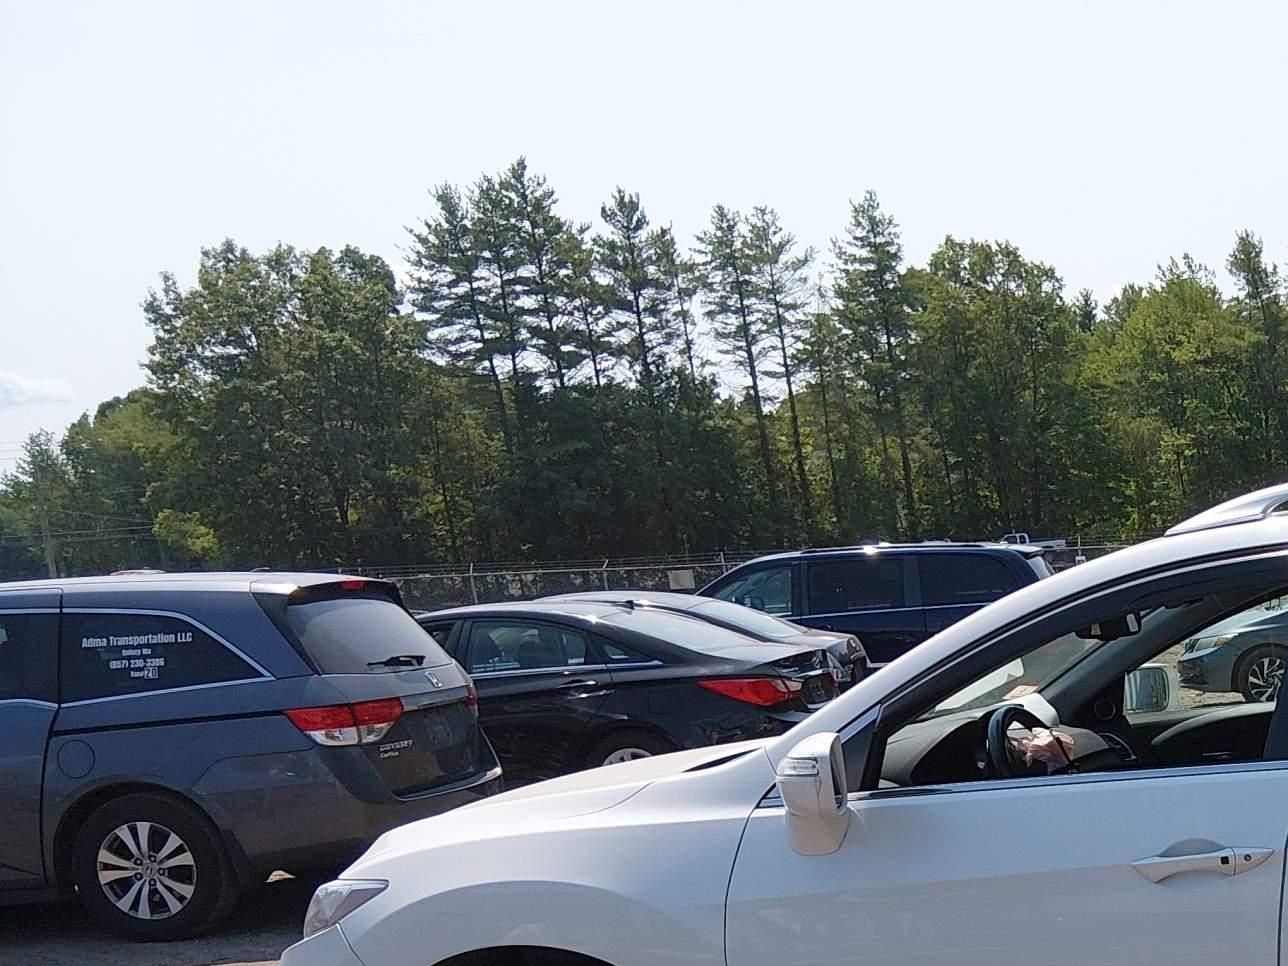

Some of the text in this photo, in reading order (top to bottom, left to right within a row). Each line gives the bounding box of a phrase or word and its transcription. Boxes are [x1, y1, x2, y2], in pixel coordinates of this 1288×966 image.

[82, 632, 193, 648] Adma Transportation LLC
